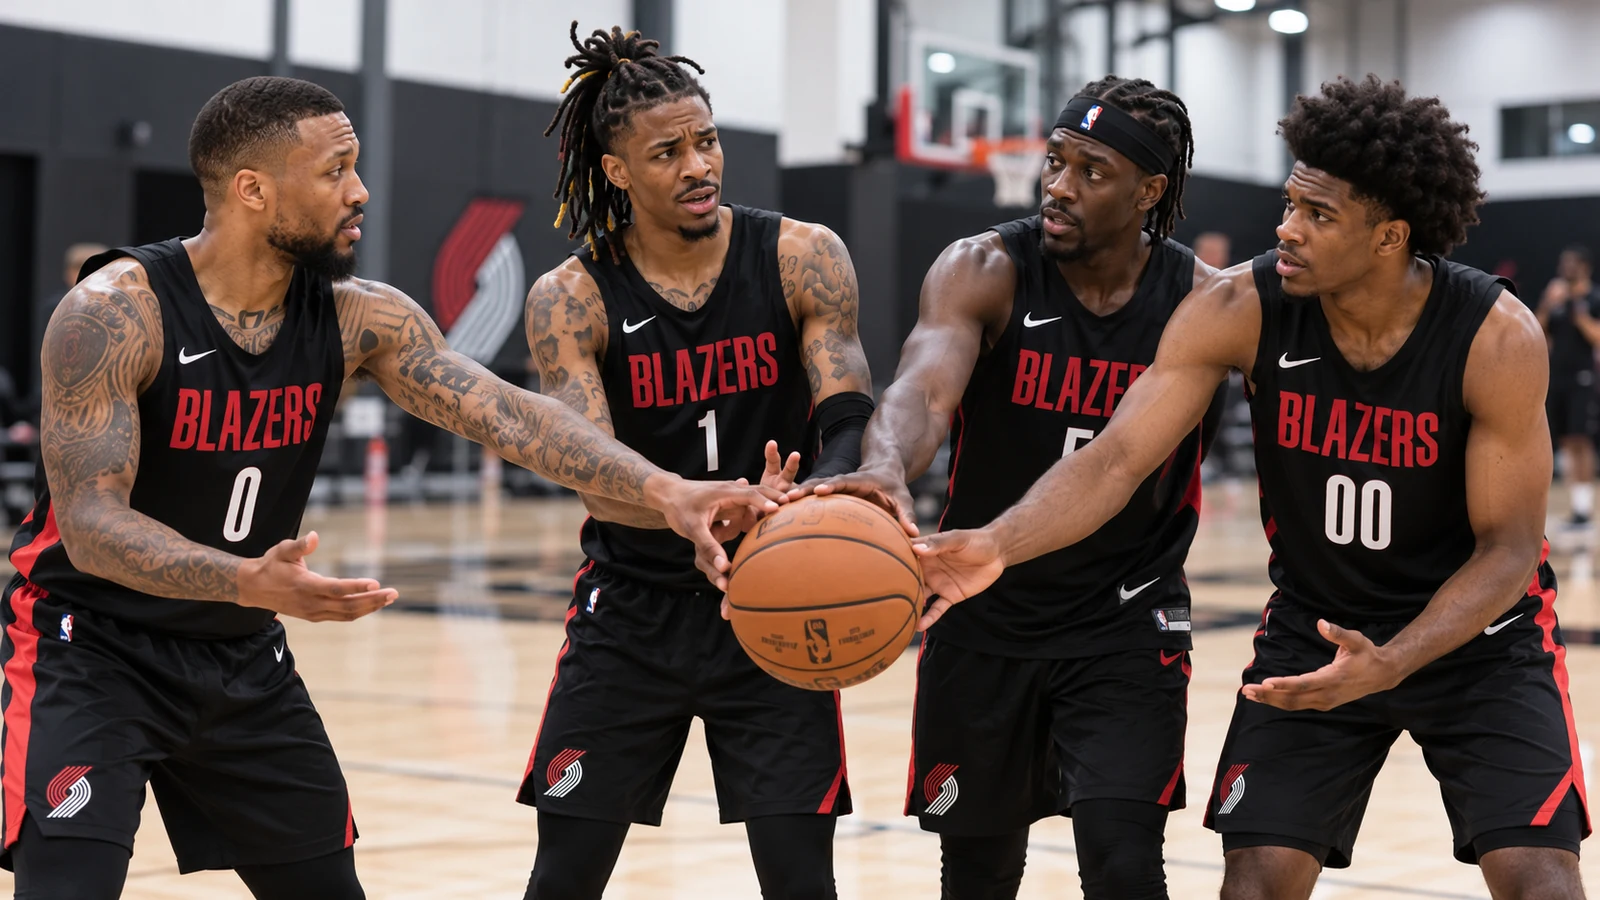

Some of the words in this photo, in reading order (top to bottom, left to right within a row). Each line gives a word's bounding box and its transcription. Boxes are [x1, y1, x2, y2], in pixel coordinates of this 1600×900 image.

[628, 332, 779, 408] BLAZERS
[169, 382, 323, 451] BLAZERS
[698, 409, 719, 472] 1
[1277, 390, 1439, 468] BLAZERS
[222, 466, 262, 542] 0
[1325, 474, 1392, 550] 00
